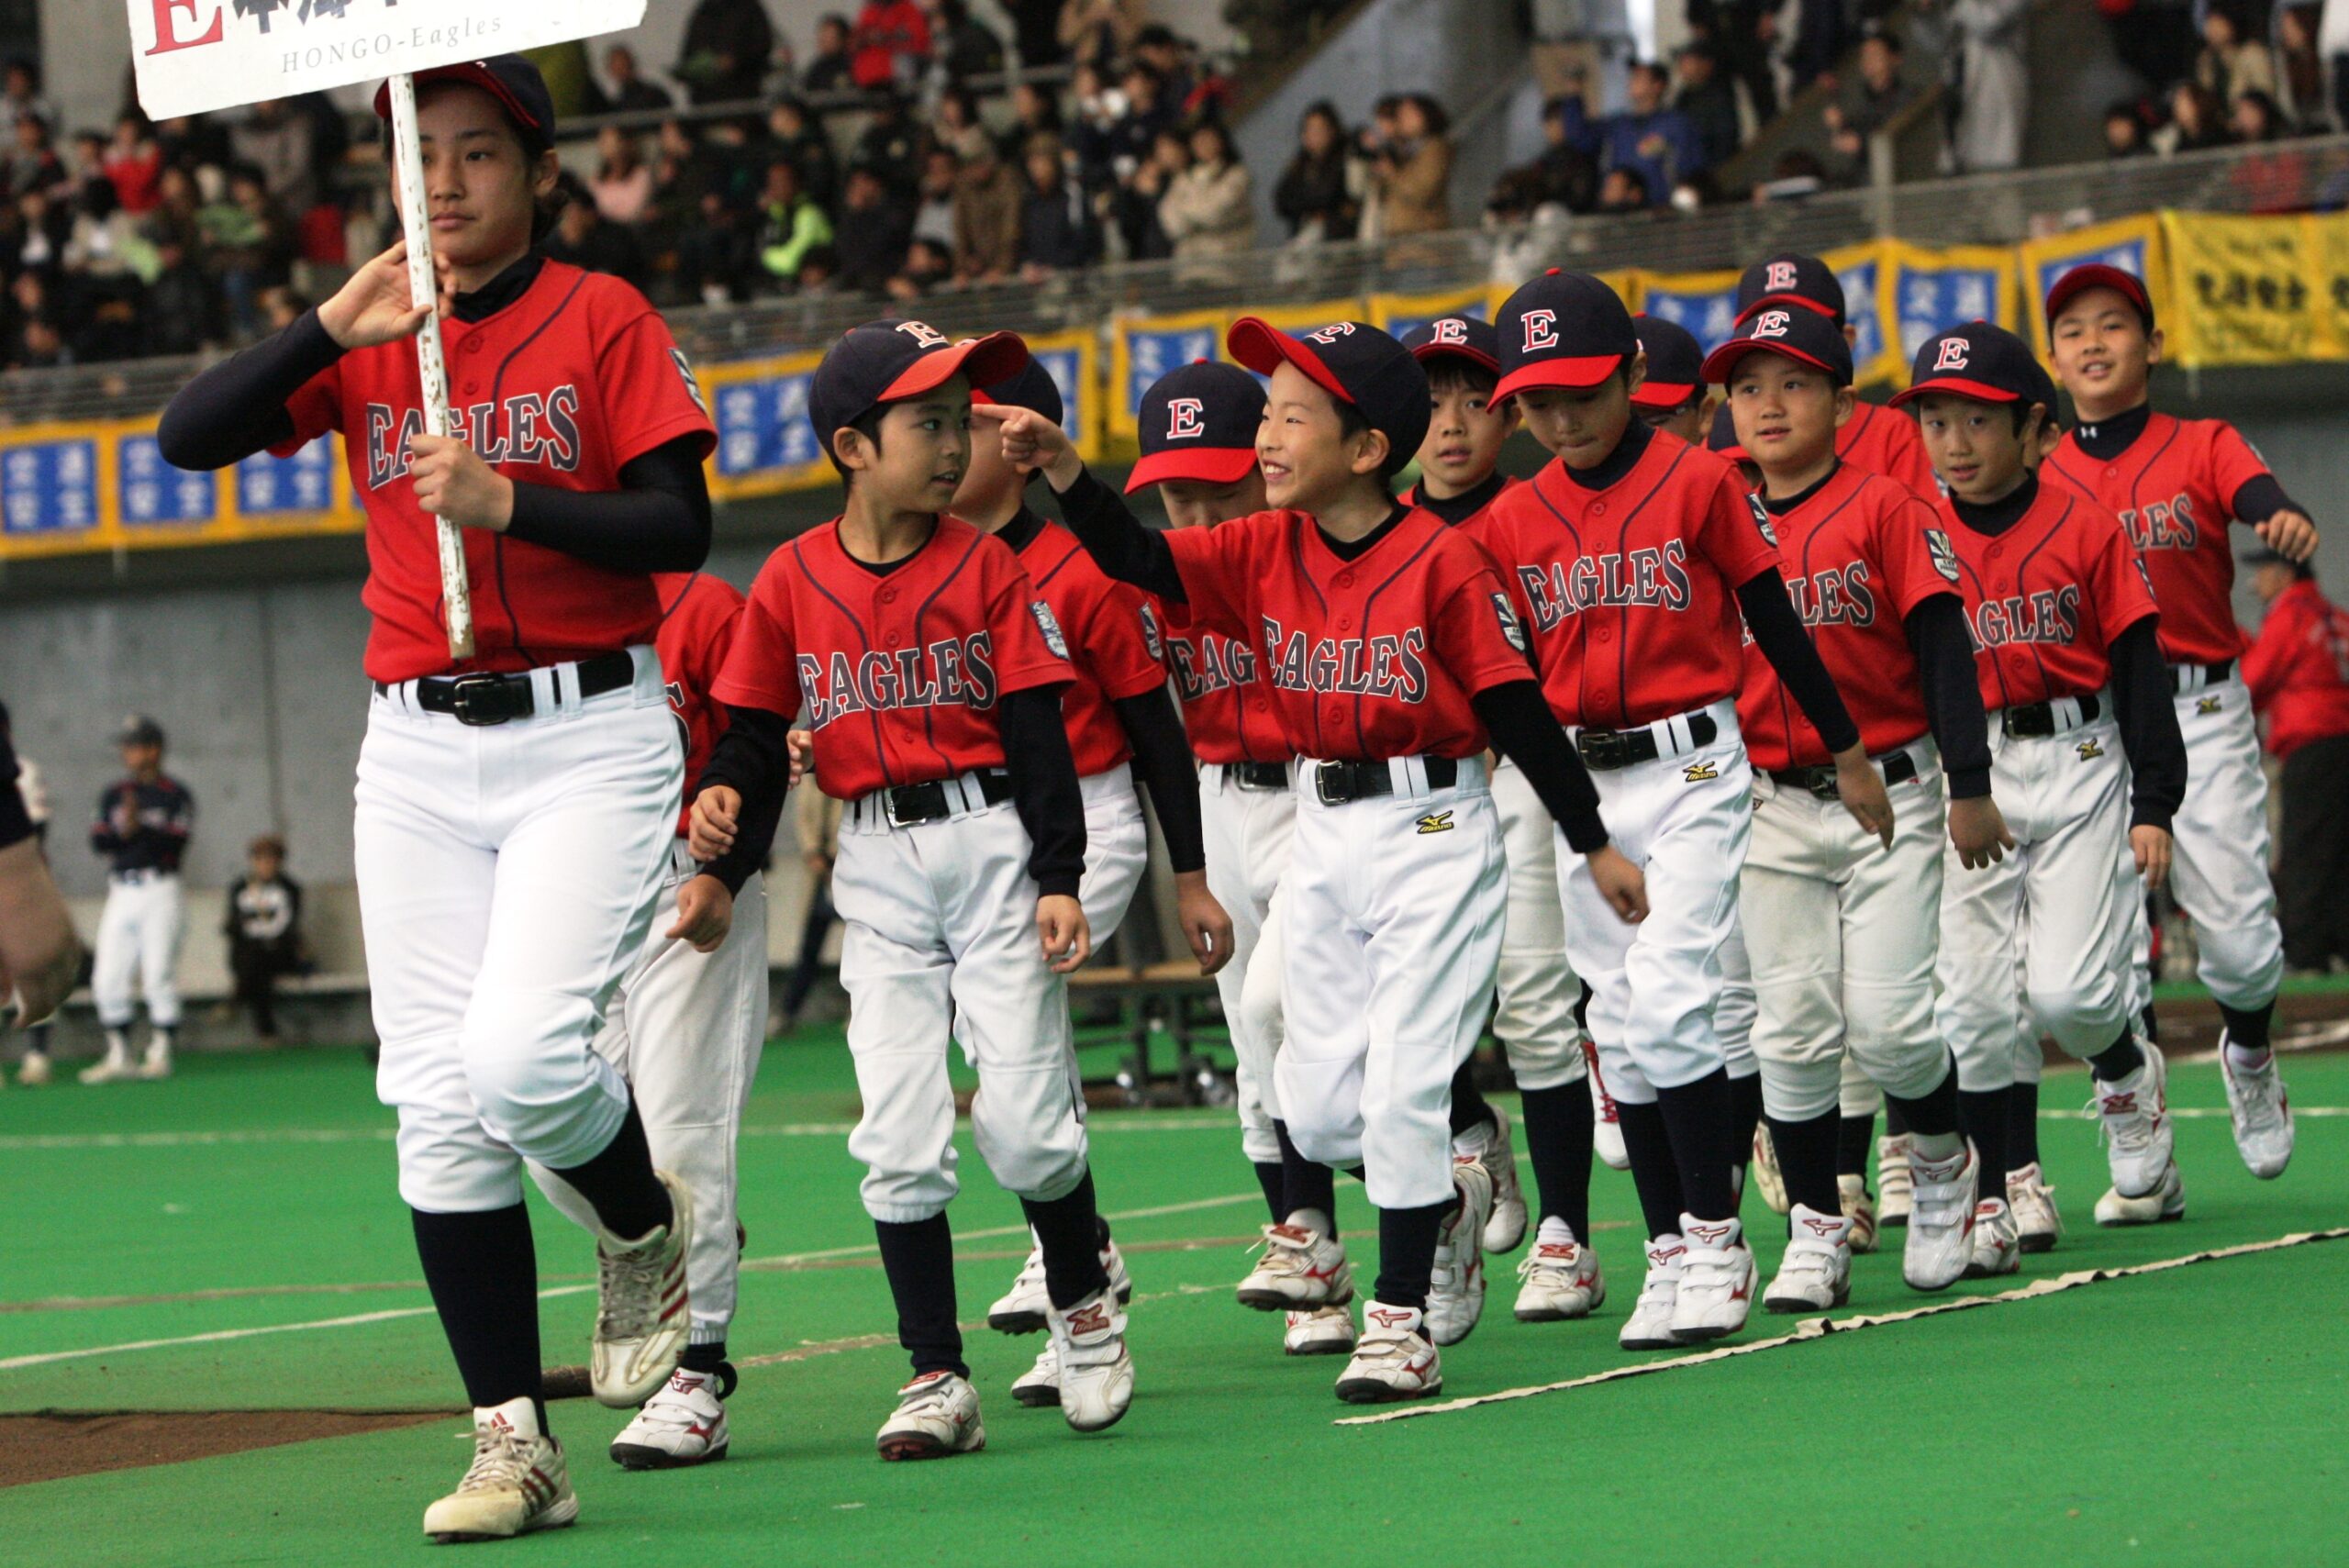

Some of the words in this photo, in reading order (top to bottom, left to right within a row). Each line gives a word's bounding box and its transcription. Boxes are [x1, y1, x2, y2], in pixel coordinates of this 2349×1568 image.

[281, 17, 502, 73] HONGO-Eagles
[1765, 261, 1798, 292] E
[1430, 318, 1468, 345] E
[1520, 309, 1560, 353] E
[1750, 310, 1790, 340] E
[1932, 338, 1970, 372] E
[1167, 398, 1204, 440] E
[1517, 538, 1691, 634] EAGLES
[1262, 613, 1427, 704] EAGLES
[796, 629, 998, 733] EAGLES
